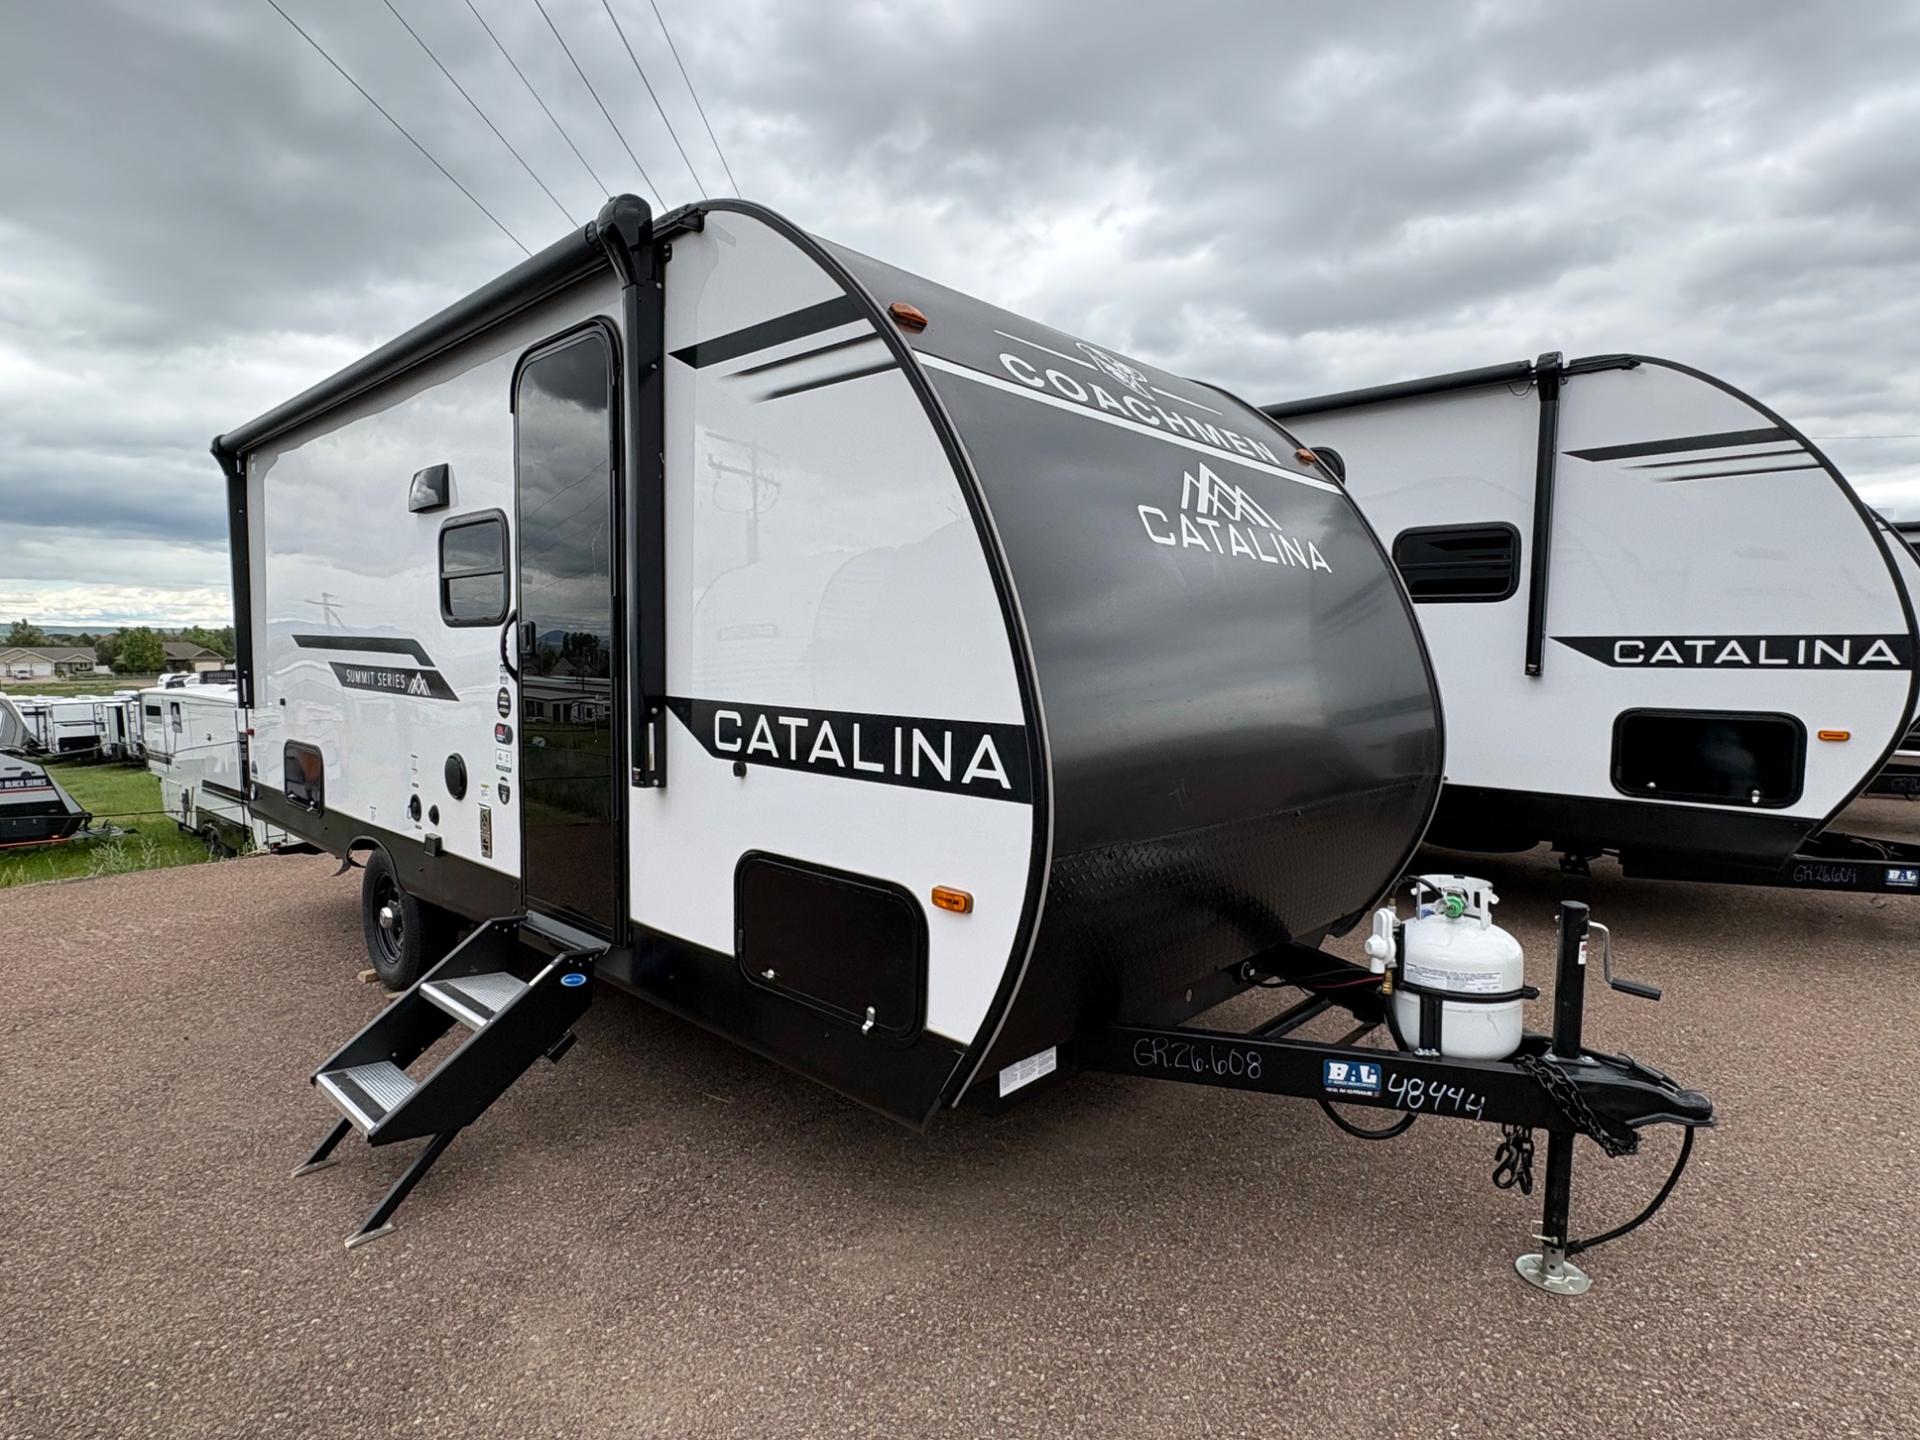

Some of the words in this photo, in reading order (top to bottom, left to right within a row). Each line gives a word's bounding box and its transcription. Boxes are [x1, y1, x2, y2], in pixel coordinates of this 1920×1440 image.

[999, 353, 1280, 466] COACHMEN
[1137, 504, 1333, 574] CATALINA
[1613, 639, 1901, 666] CATALINA
[346, 669, 375, 685] SUMMIT
[377, 673, 406, 689] SERIES
[714, 709, 1012, 790] CATALINA
[1887, 869, 1918, 881] BAL
[1328, 1062, 1378, 1084] BAL
[1387, 1072, 1486, 1121] 48444
